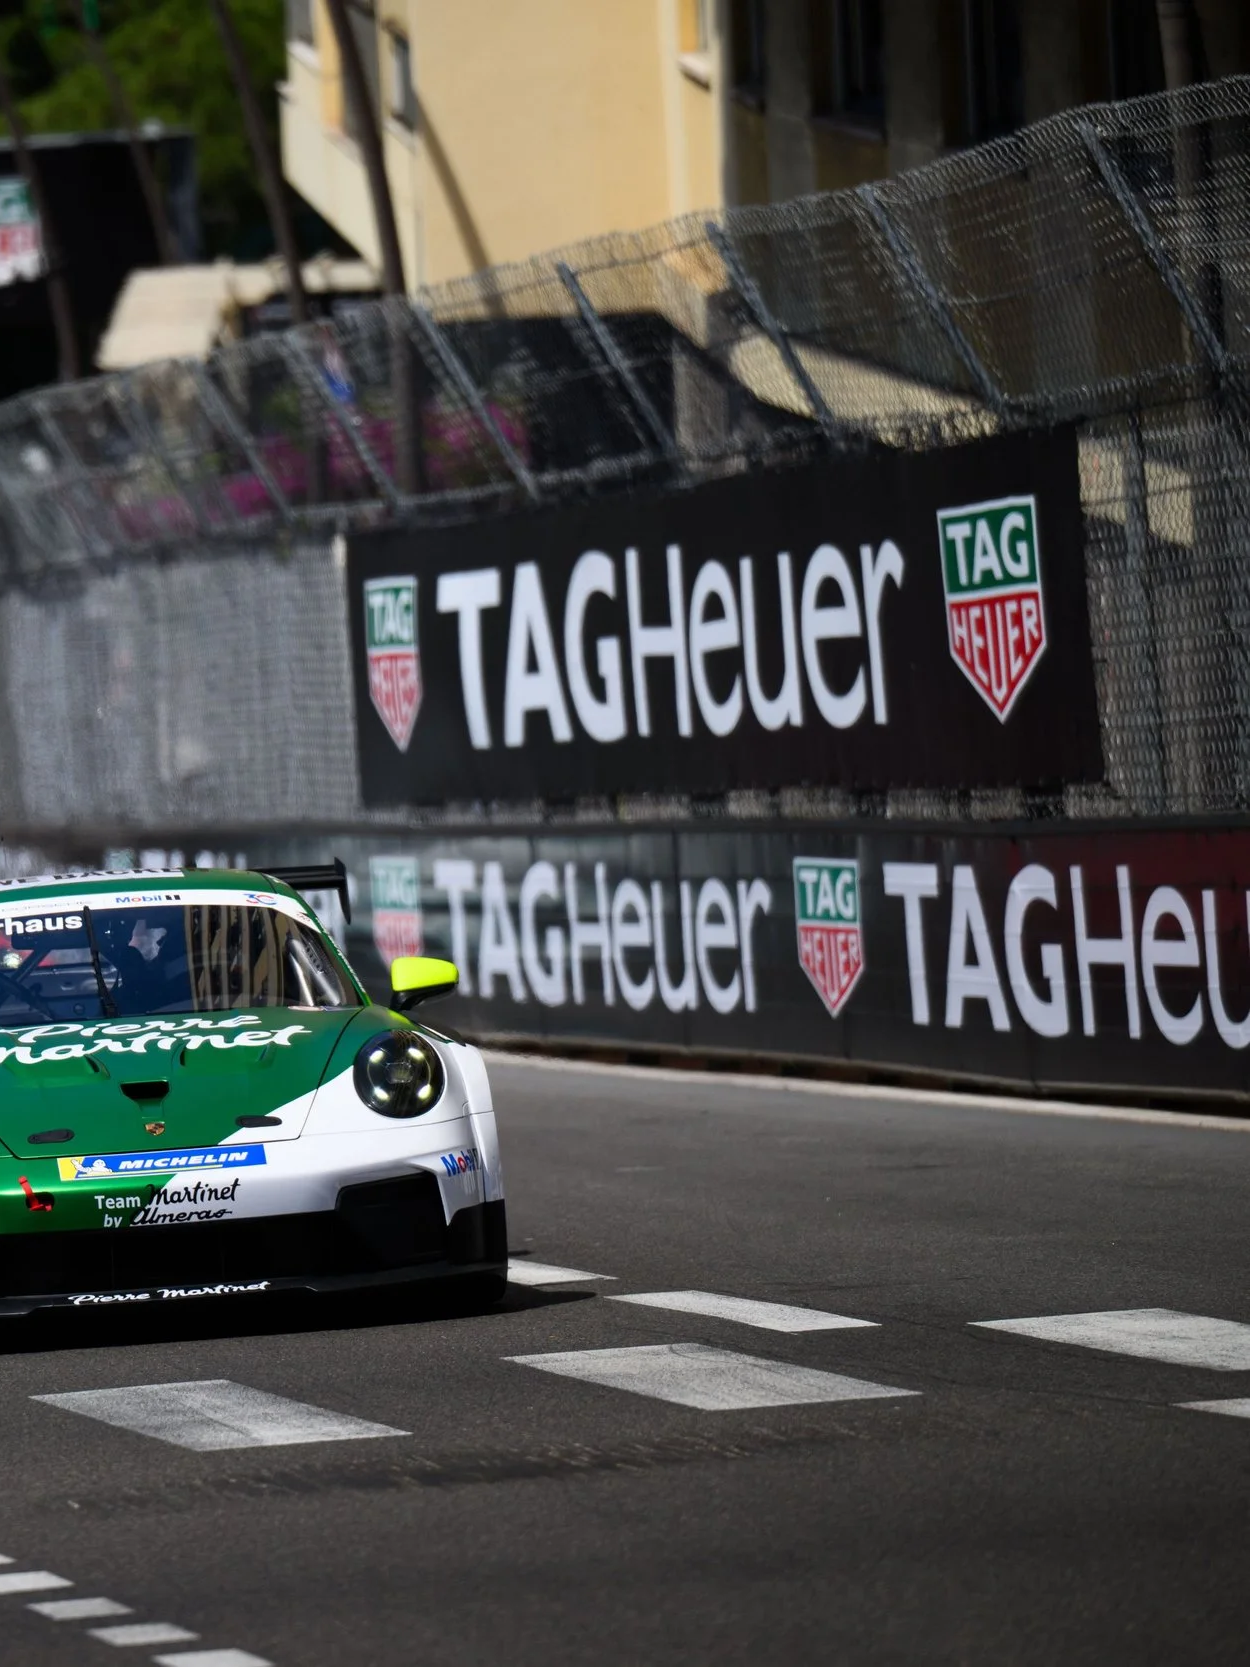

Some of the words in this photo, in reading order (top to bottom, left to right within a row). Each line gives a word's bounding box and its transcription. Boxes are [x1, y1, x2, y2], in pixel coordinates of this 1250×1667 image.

[946, 511, 1030, 586] TAG
[368, 589, 414, 644] TAG
[951, 598, 1039, 704] HEUER
[115, 894, 162, 904] Mobil
[799, 867, 855, 920] TAG
[800, 929, 859, 1001] HEUER
[118, 1151, 249, 1171] MICHELIN
[94, 1194, 141, 1210] Team
[146, 1178, 241, 1206] Martinet
[103, 1213, 123, 1229] by
[68, 1293, 150, 1306] Pierre
